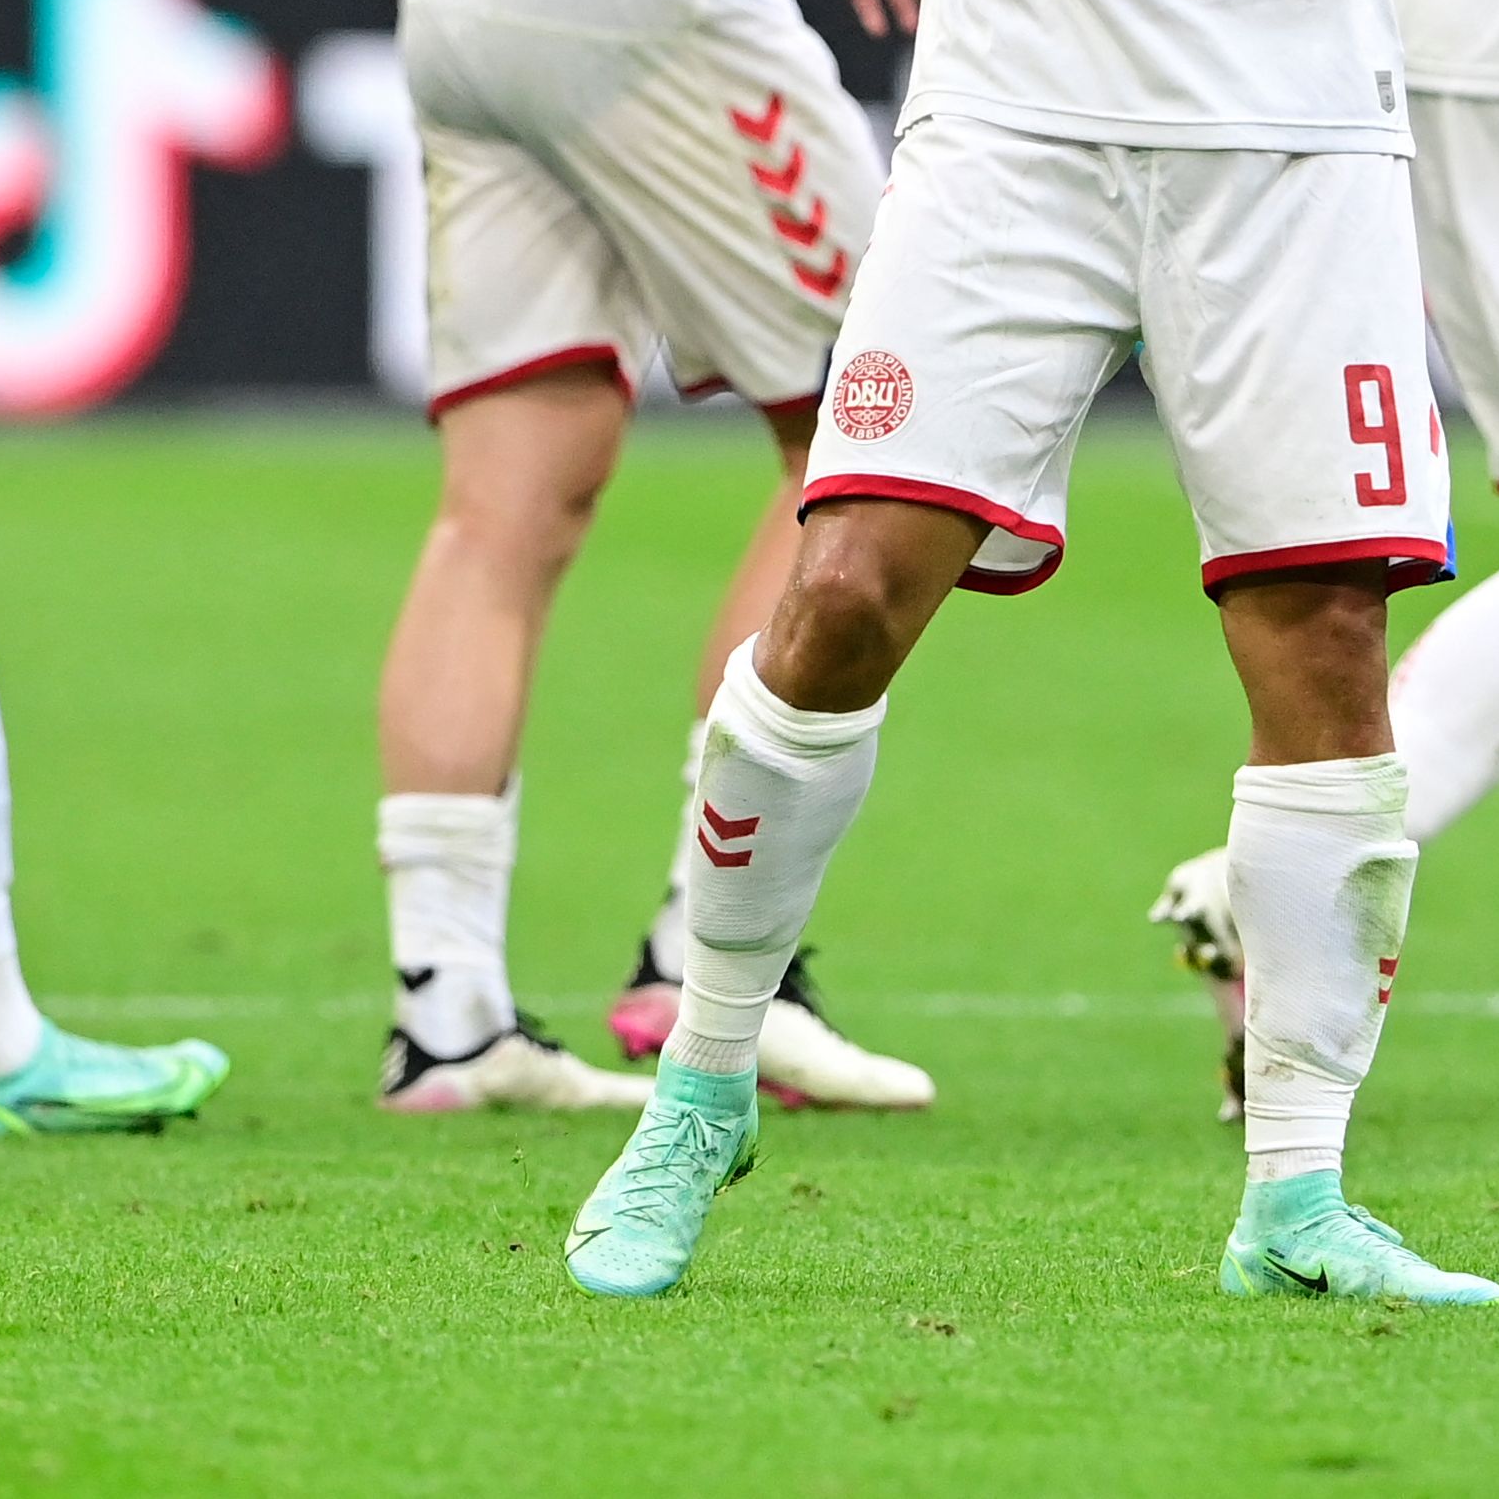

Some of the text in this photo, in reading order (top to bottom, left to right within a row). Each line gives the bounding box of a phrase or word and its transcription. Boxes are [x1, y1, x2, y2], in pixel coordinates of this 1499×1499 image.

[844, 379, 896, 408] DBU
[850, 426, 885, 440] 1889
[1342, 363, 1407, 508] 9
